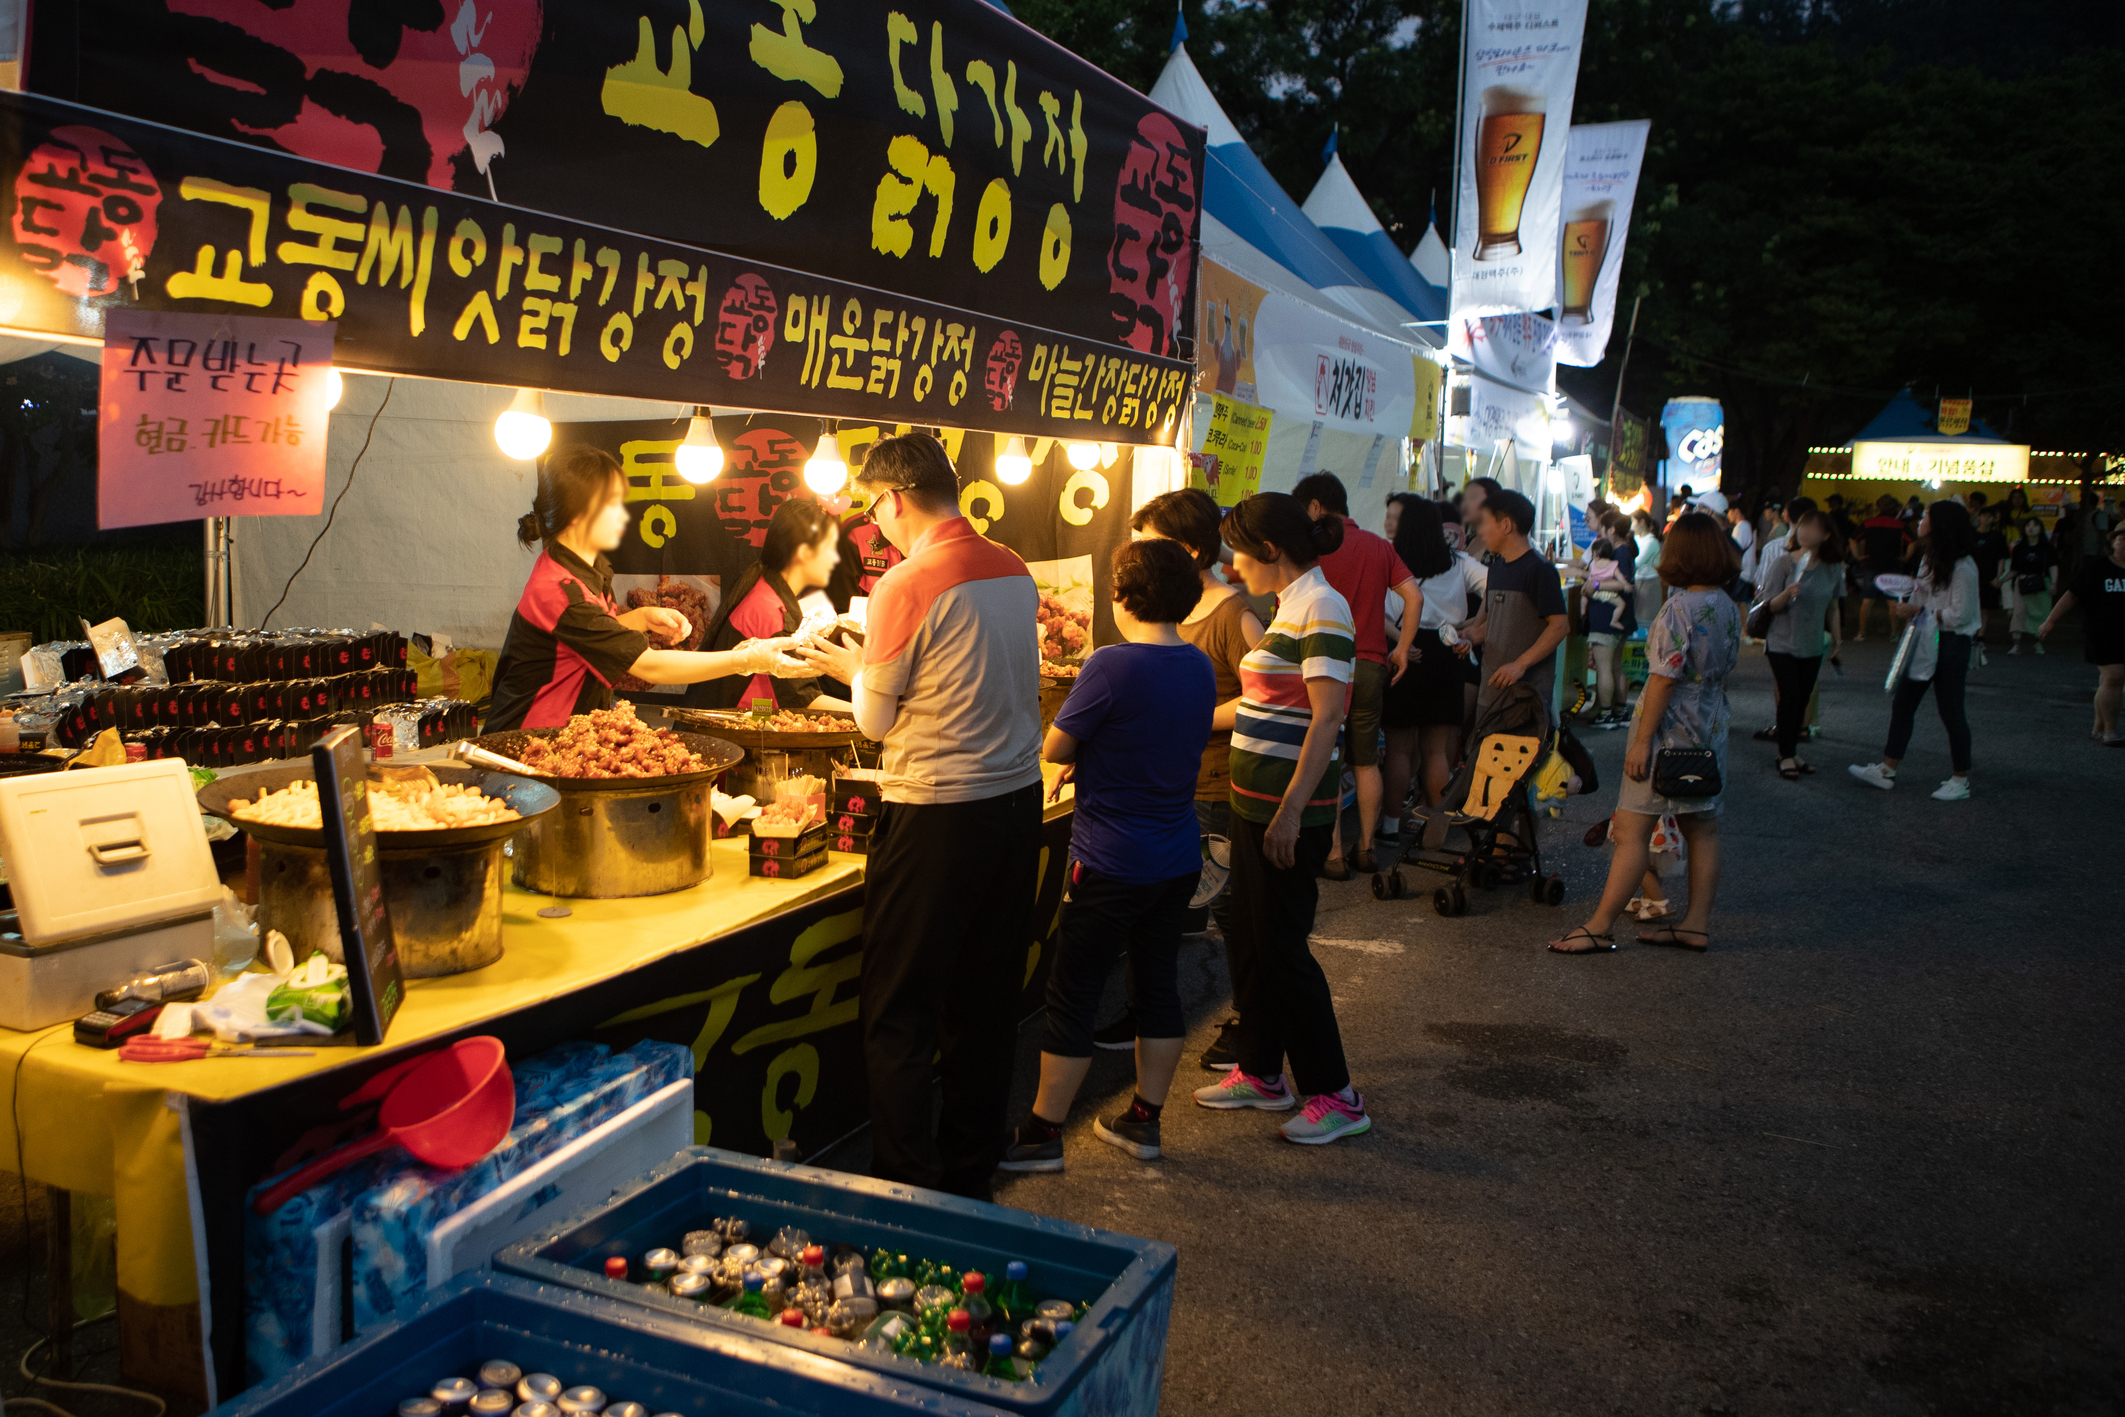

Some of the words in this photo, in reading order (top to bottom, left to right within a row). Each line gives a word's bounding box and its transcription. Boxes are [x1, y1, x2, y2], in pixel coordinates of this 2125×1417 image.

[1489, 156, 1496, 164] D
[1499, 153, 1529, 163] FIRST
[166, 177, 708, 369] 교동씨앗닭강정
[784, 293, 976, 406] 매운닭강정
[1029, 343, 1187, 433] 마늘간장닭강정
[1329, 357, 1366, 420] 처갓집
[1365, 397, 1376, 423] 치킨
[1878, 456, 1911, 474] 안내
[1928, 457, 1996, 476] 기념품샵
